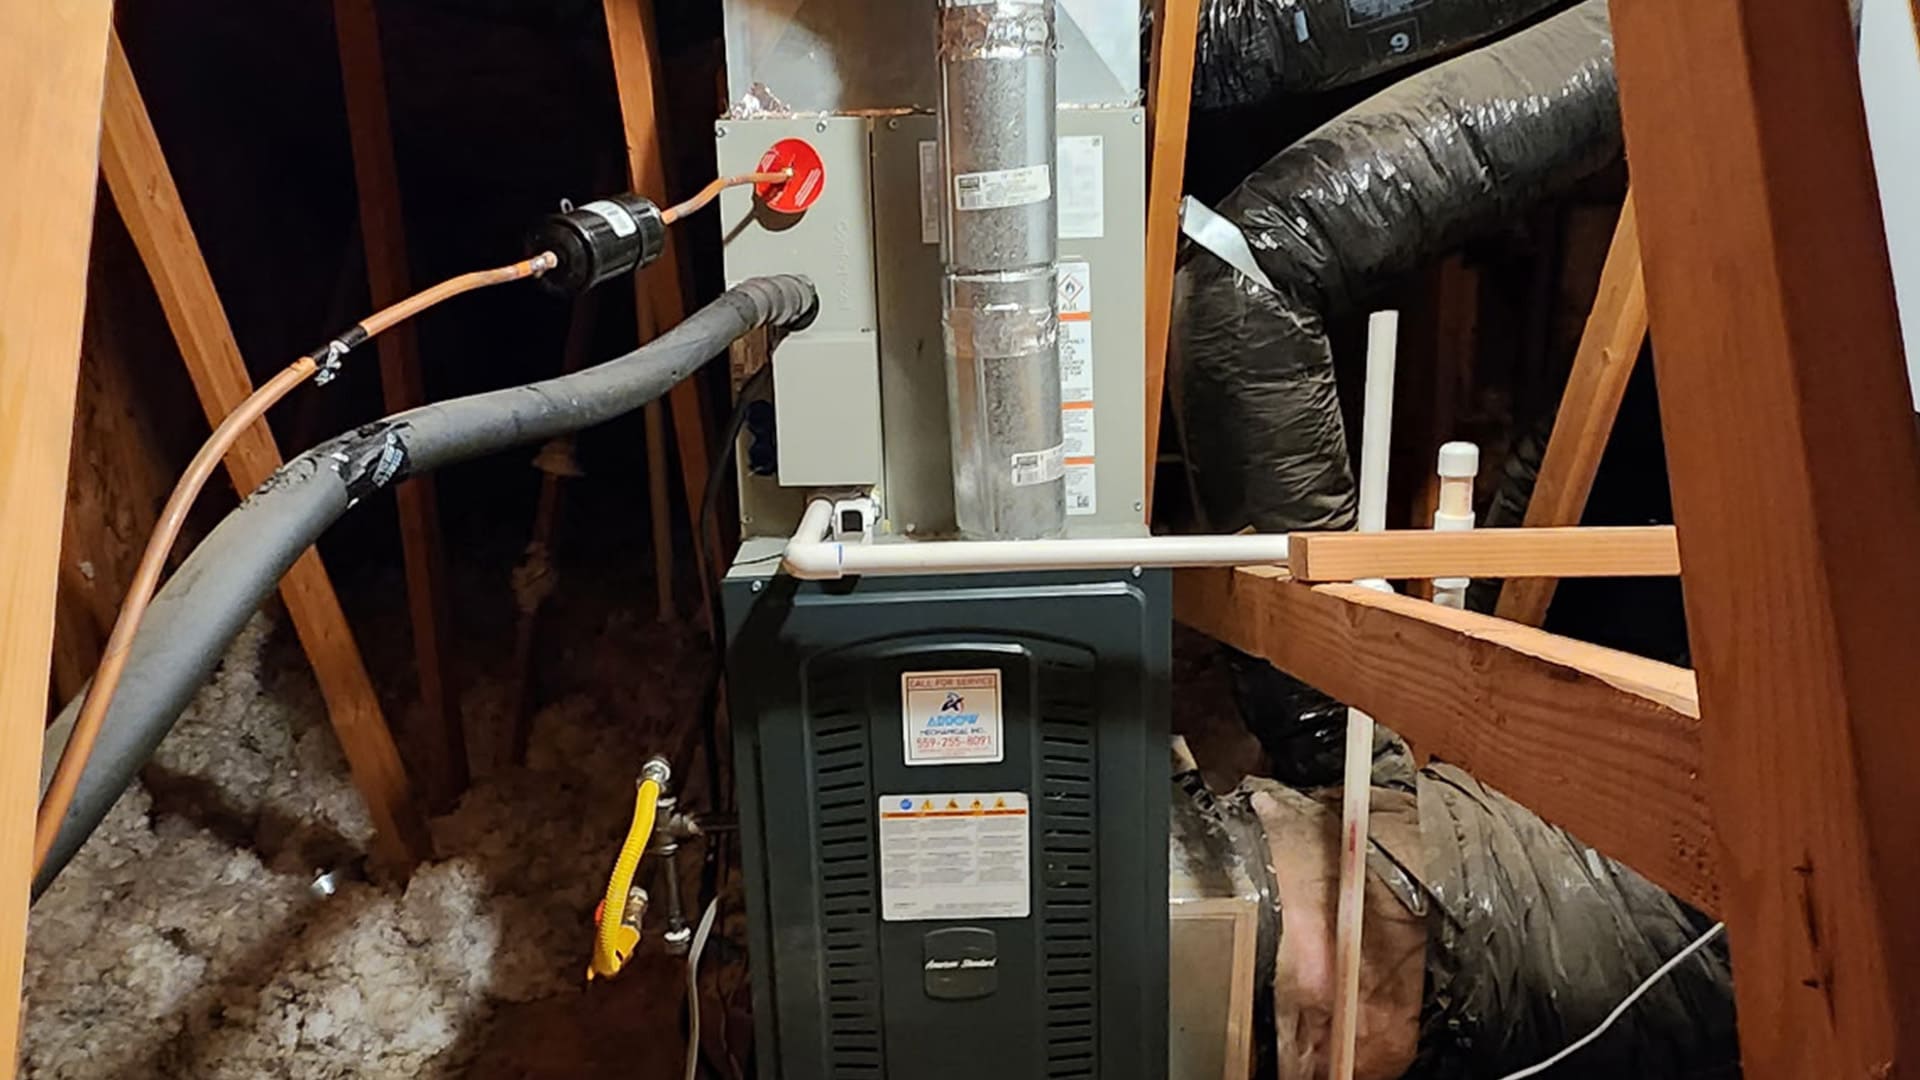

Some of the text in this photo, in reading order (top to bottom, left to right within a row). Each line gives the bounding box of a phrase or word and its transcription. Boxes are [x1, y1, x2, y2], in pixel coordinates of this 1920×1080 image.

[1390, 33, 1409, 52] 9
[910, 677, 994, 689] CALL FOR SERVICE
[960, 958, 997, 968] Standard
